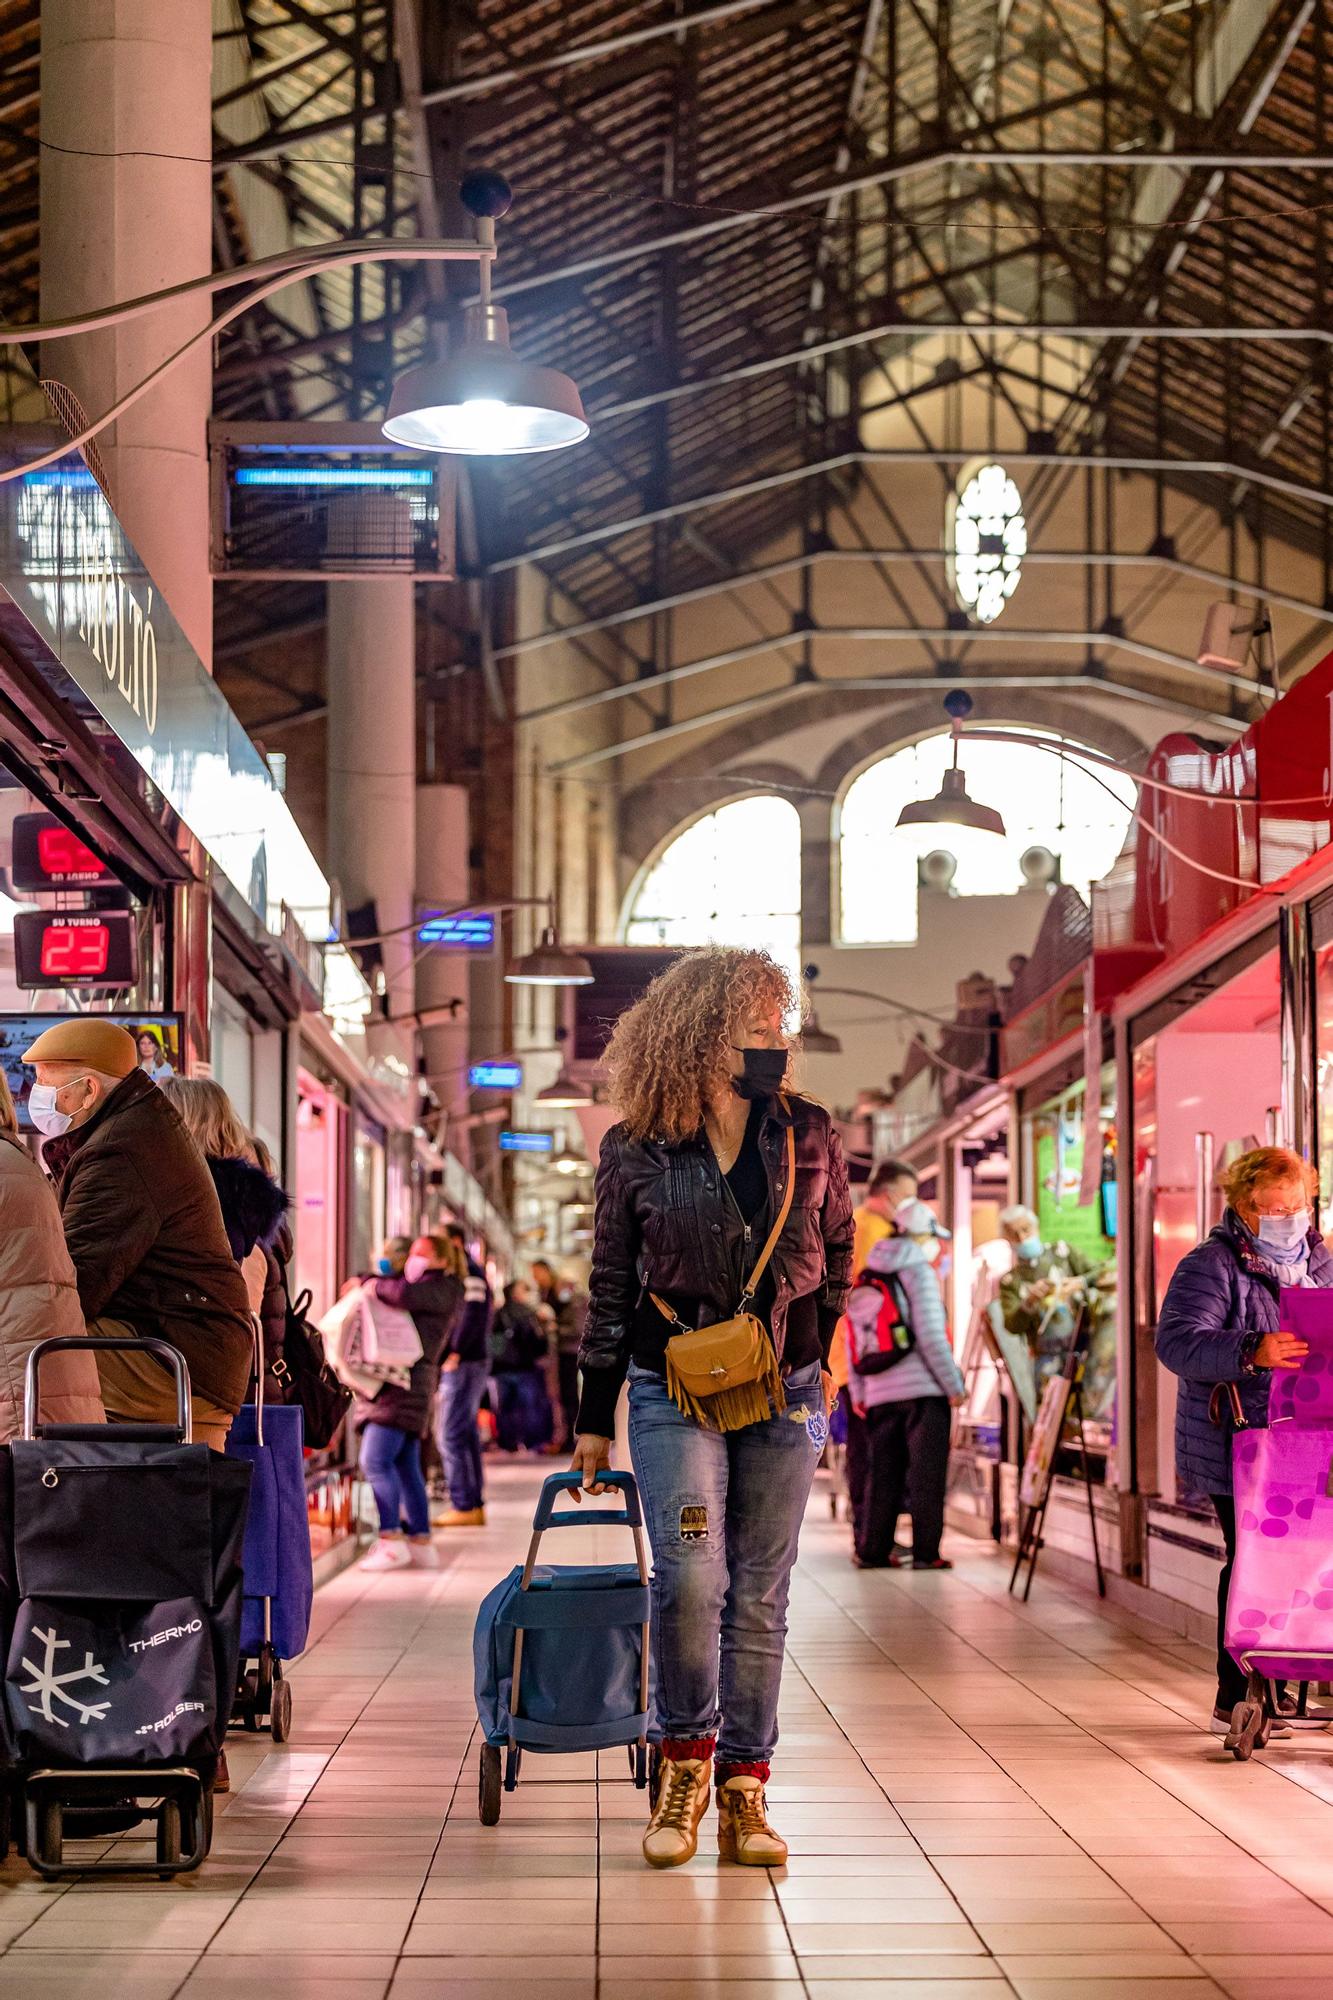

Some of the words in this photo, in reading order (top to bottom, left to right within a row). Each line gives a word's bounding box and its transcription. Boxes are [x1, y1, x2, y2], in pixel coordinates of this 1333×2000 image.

[78, 507, 158, 736] MOLTÓ
[52, 918, 65, 927] SU
[67, 918, 101, 927] TURNO
[44, 927, 107, 973] 23
[128, 1619, 203, 1653] THERMO
[154, 1701, 205, 1733] ROLSER
